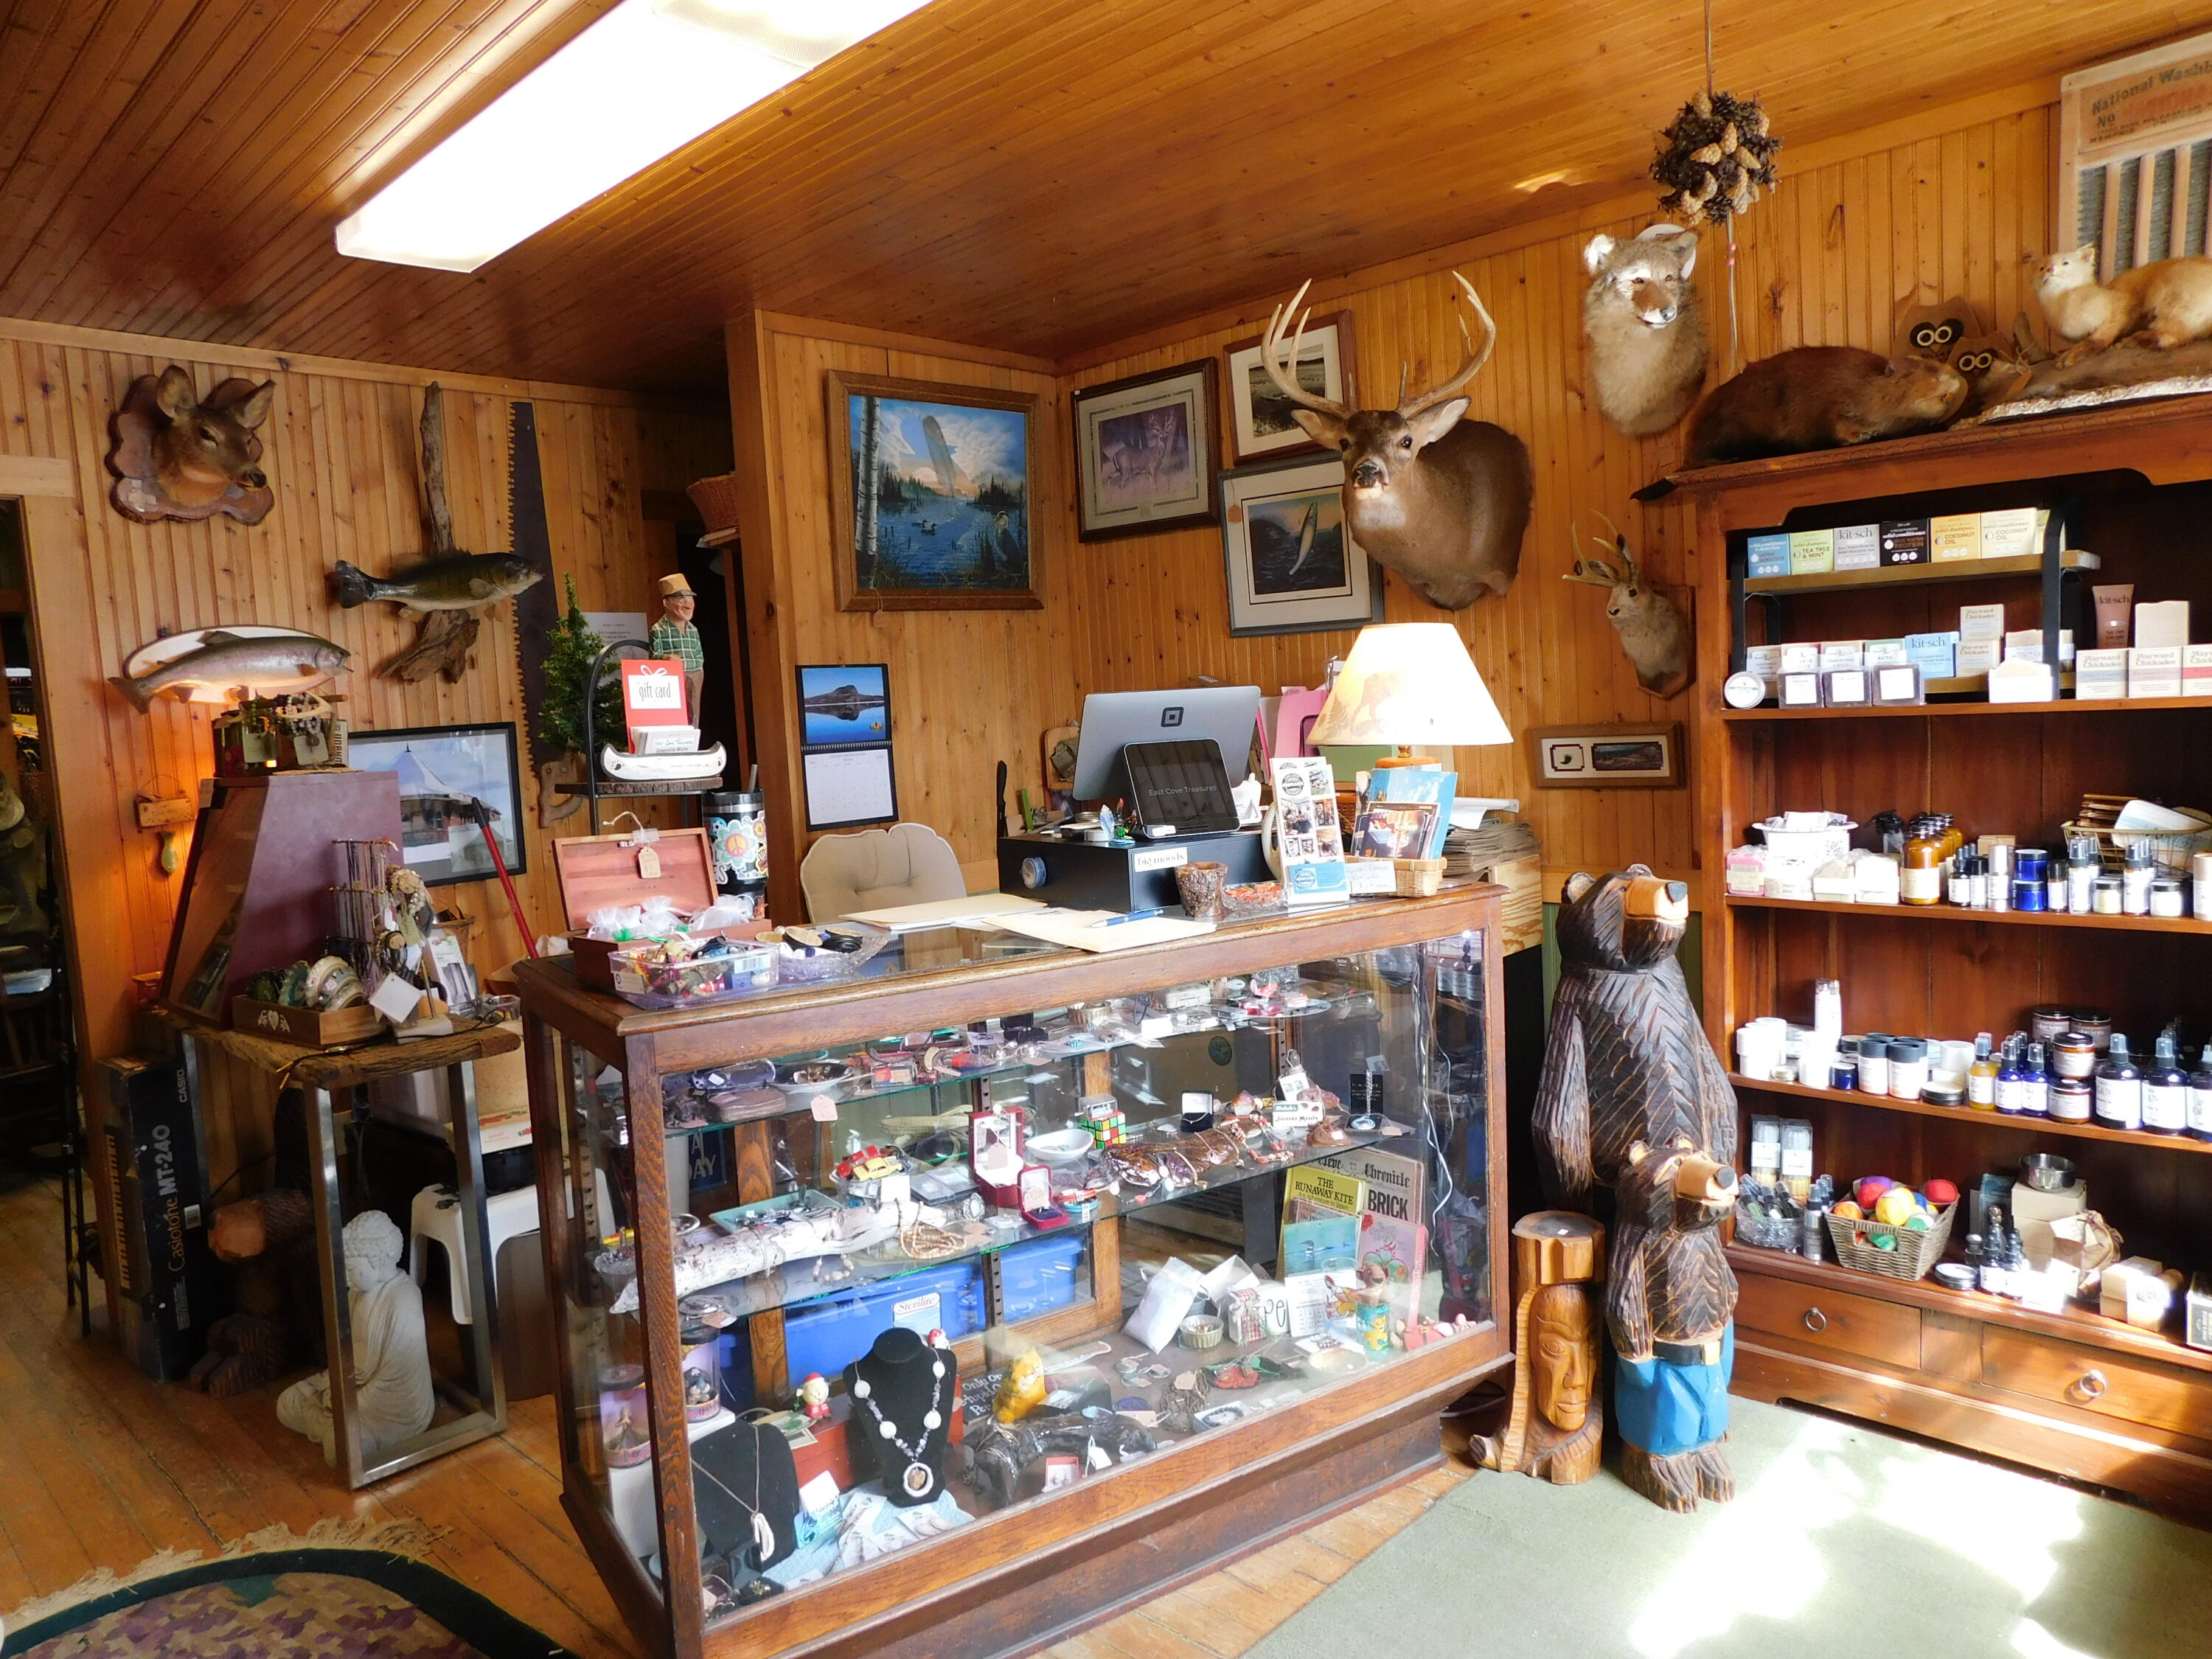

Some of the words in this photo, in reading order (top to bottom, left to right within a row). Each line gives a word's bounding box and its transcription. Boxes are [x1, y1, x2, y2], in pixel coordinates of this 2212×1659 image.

[2092, 77, 2153, 116] National
[1995, 527, 2028, 536] COCONUT
[2083, 660, 2121, 668] Chickadee
[2136, 658, 2176, 667] Chickadee
[2137, 652, 2174, 661] Wayward
[639, 681, 653, 700] gift
[655, 683, 671, 698] card
[1185, 785, 1217, 793] Treasures
[178, 1068, 187, 1102] CASIO
[152, 1124, 179, 1197] MT-240
[1318, 1177, 1334, 1189] THE
[1365, 1162, 1411, 1188] Chronicle
[1295, 1181, 1334, 1199] RUNAWAY
[1335, 1192, 1354, 1205] KITE
[1307, 1193, 1330, 1204] Adventure
[1336, 1201, 1349, 1210] Japan
[1368, 1189, 1408, 1221] BRICK
[167, 1197, 184, 1273] Casiotone
[899, 1297, 938, 1311] Sterilite
[962, 1377, 989, 1391] Only
